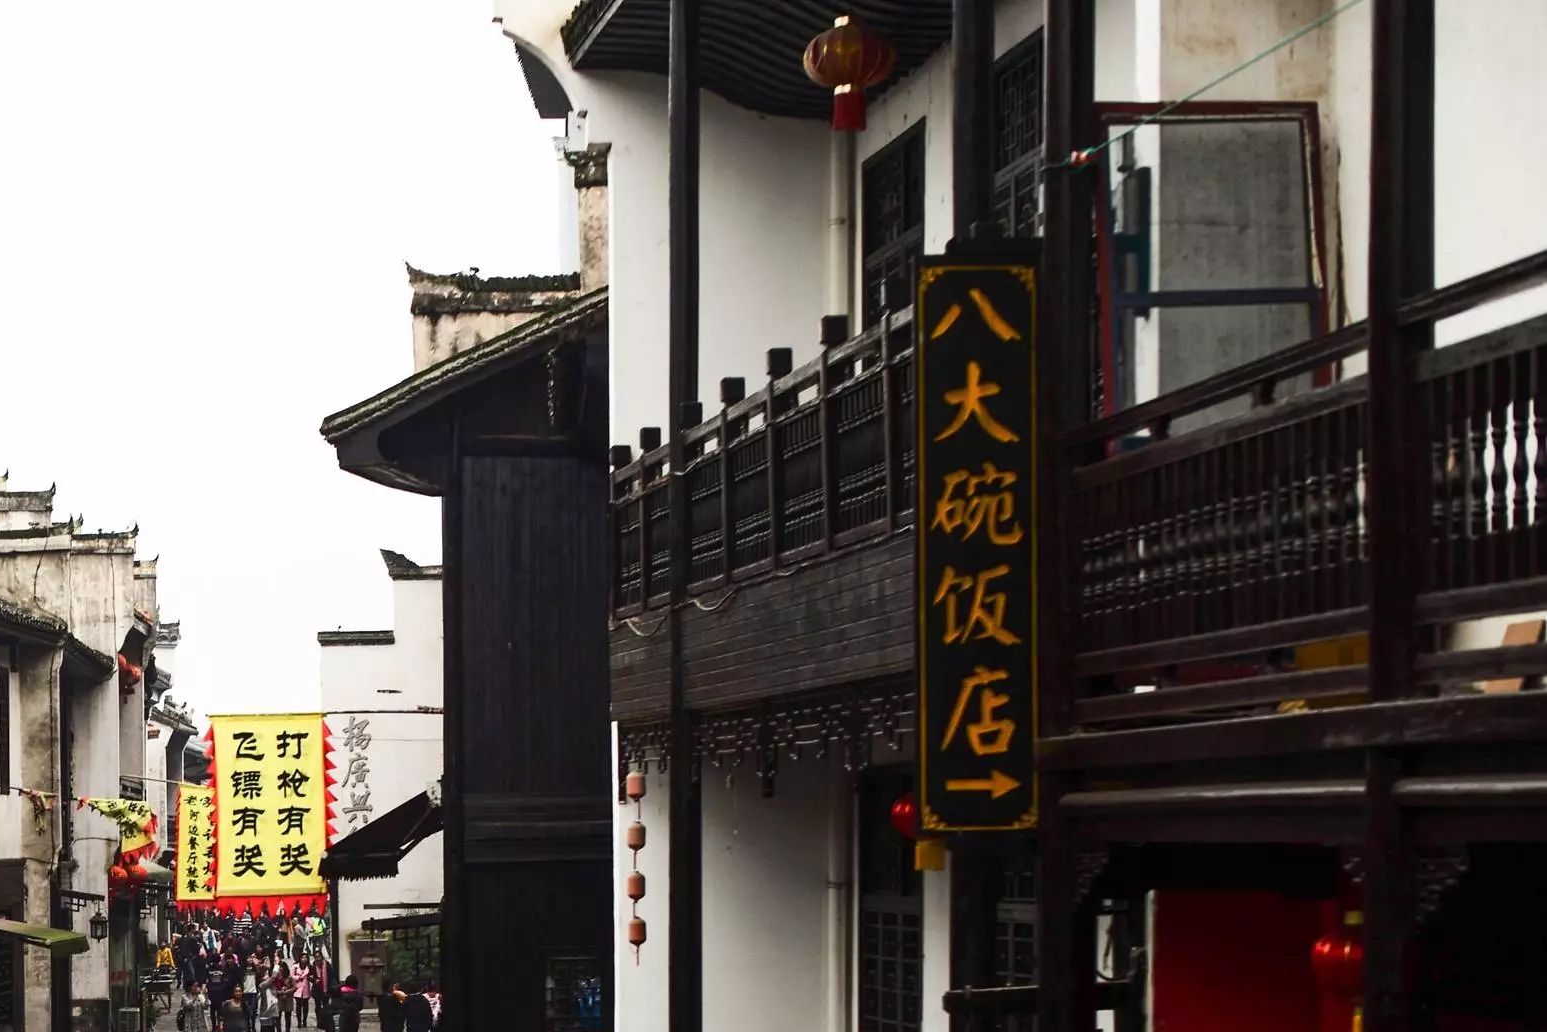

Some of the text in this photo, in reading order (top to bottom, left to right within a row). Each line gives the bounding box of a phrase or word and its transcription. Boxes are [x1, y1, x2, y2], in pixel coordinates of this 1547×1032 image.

[930, 288, 1023, 756] 八大碗饭店
[231, 731, 266, 877] 飞镖有奖
[277, 730, 313, 877] 打枪有奖
